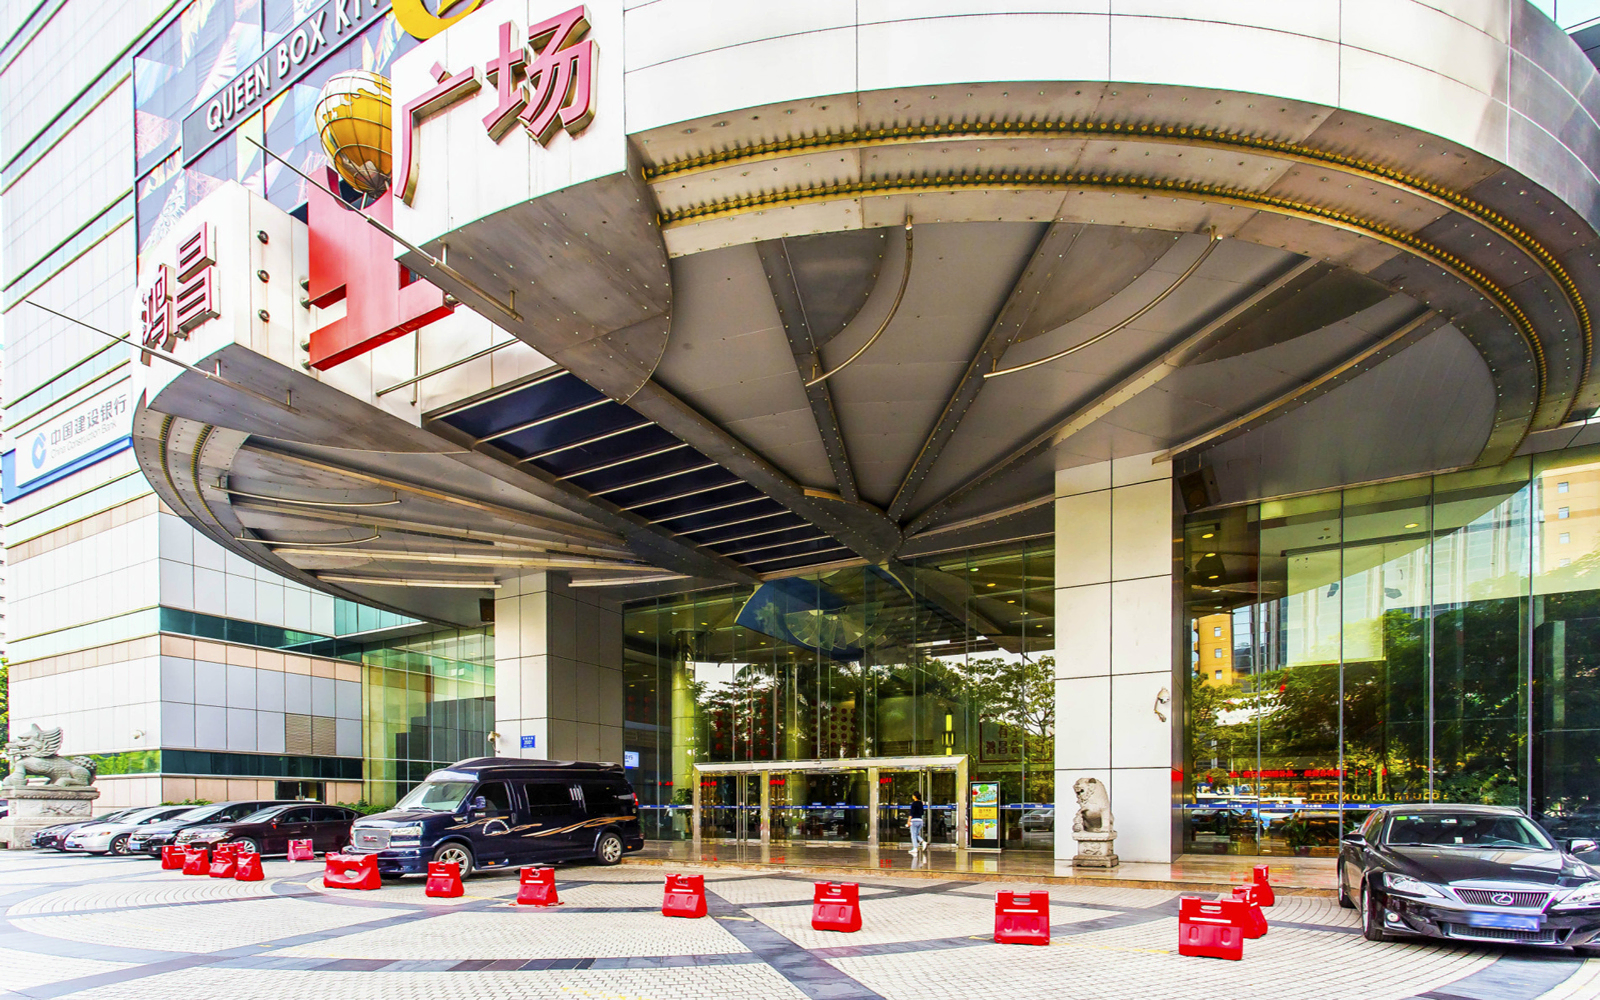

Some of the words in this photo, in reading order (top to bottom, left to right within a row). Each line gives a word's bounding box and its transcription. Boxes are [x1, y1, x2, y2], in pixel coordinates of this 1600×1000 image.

[206, 56, 271, 132] QUEEN
[277, 10, 327, 79] BOX
[394, 4, 600, 208] 广场
[140, 221, 221, 367] 鸿昌
[51, 394, 127, 445] 中国建设银行
[51, 445, 66, 458] China
[67, 428, 101, 451] Construction
[101, 420, 117, 434] Bank
